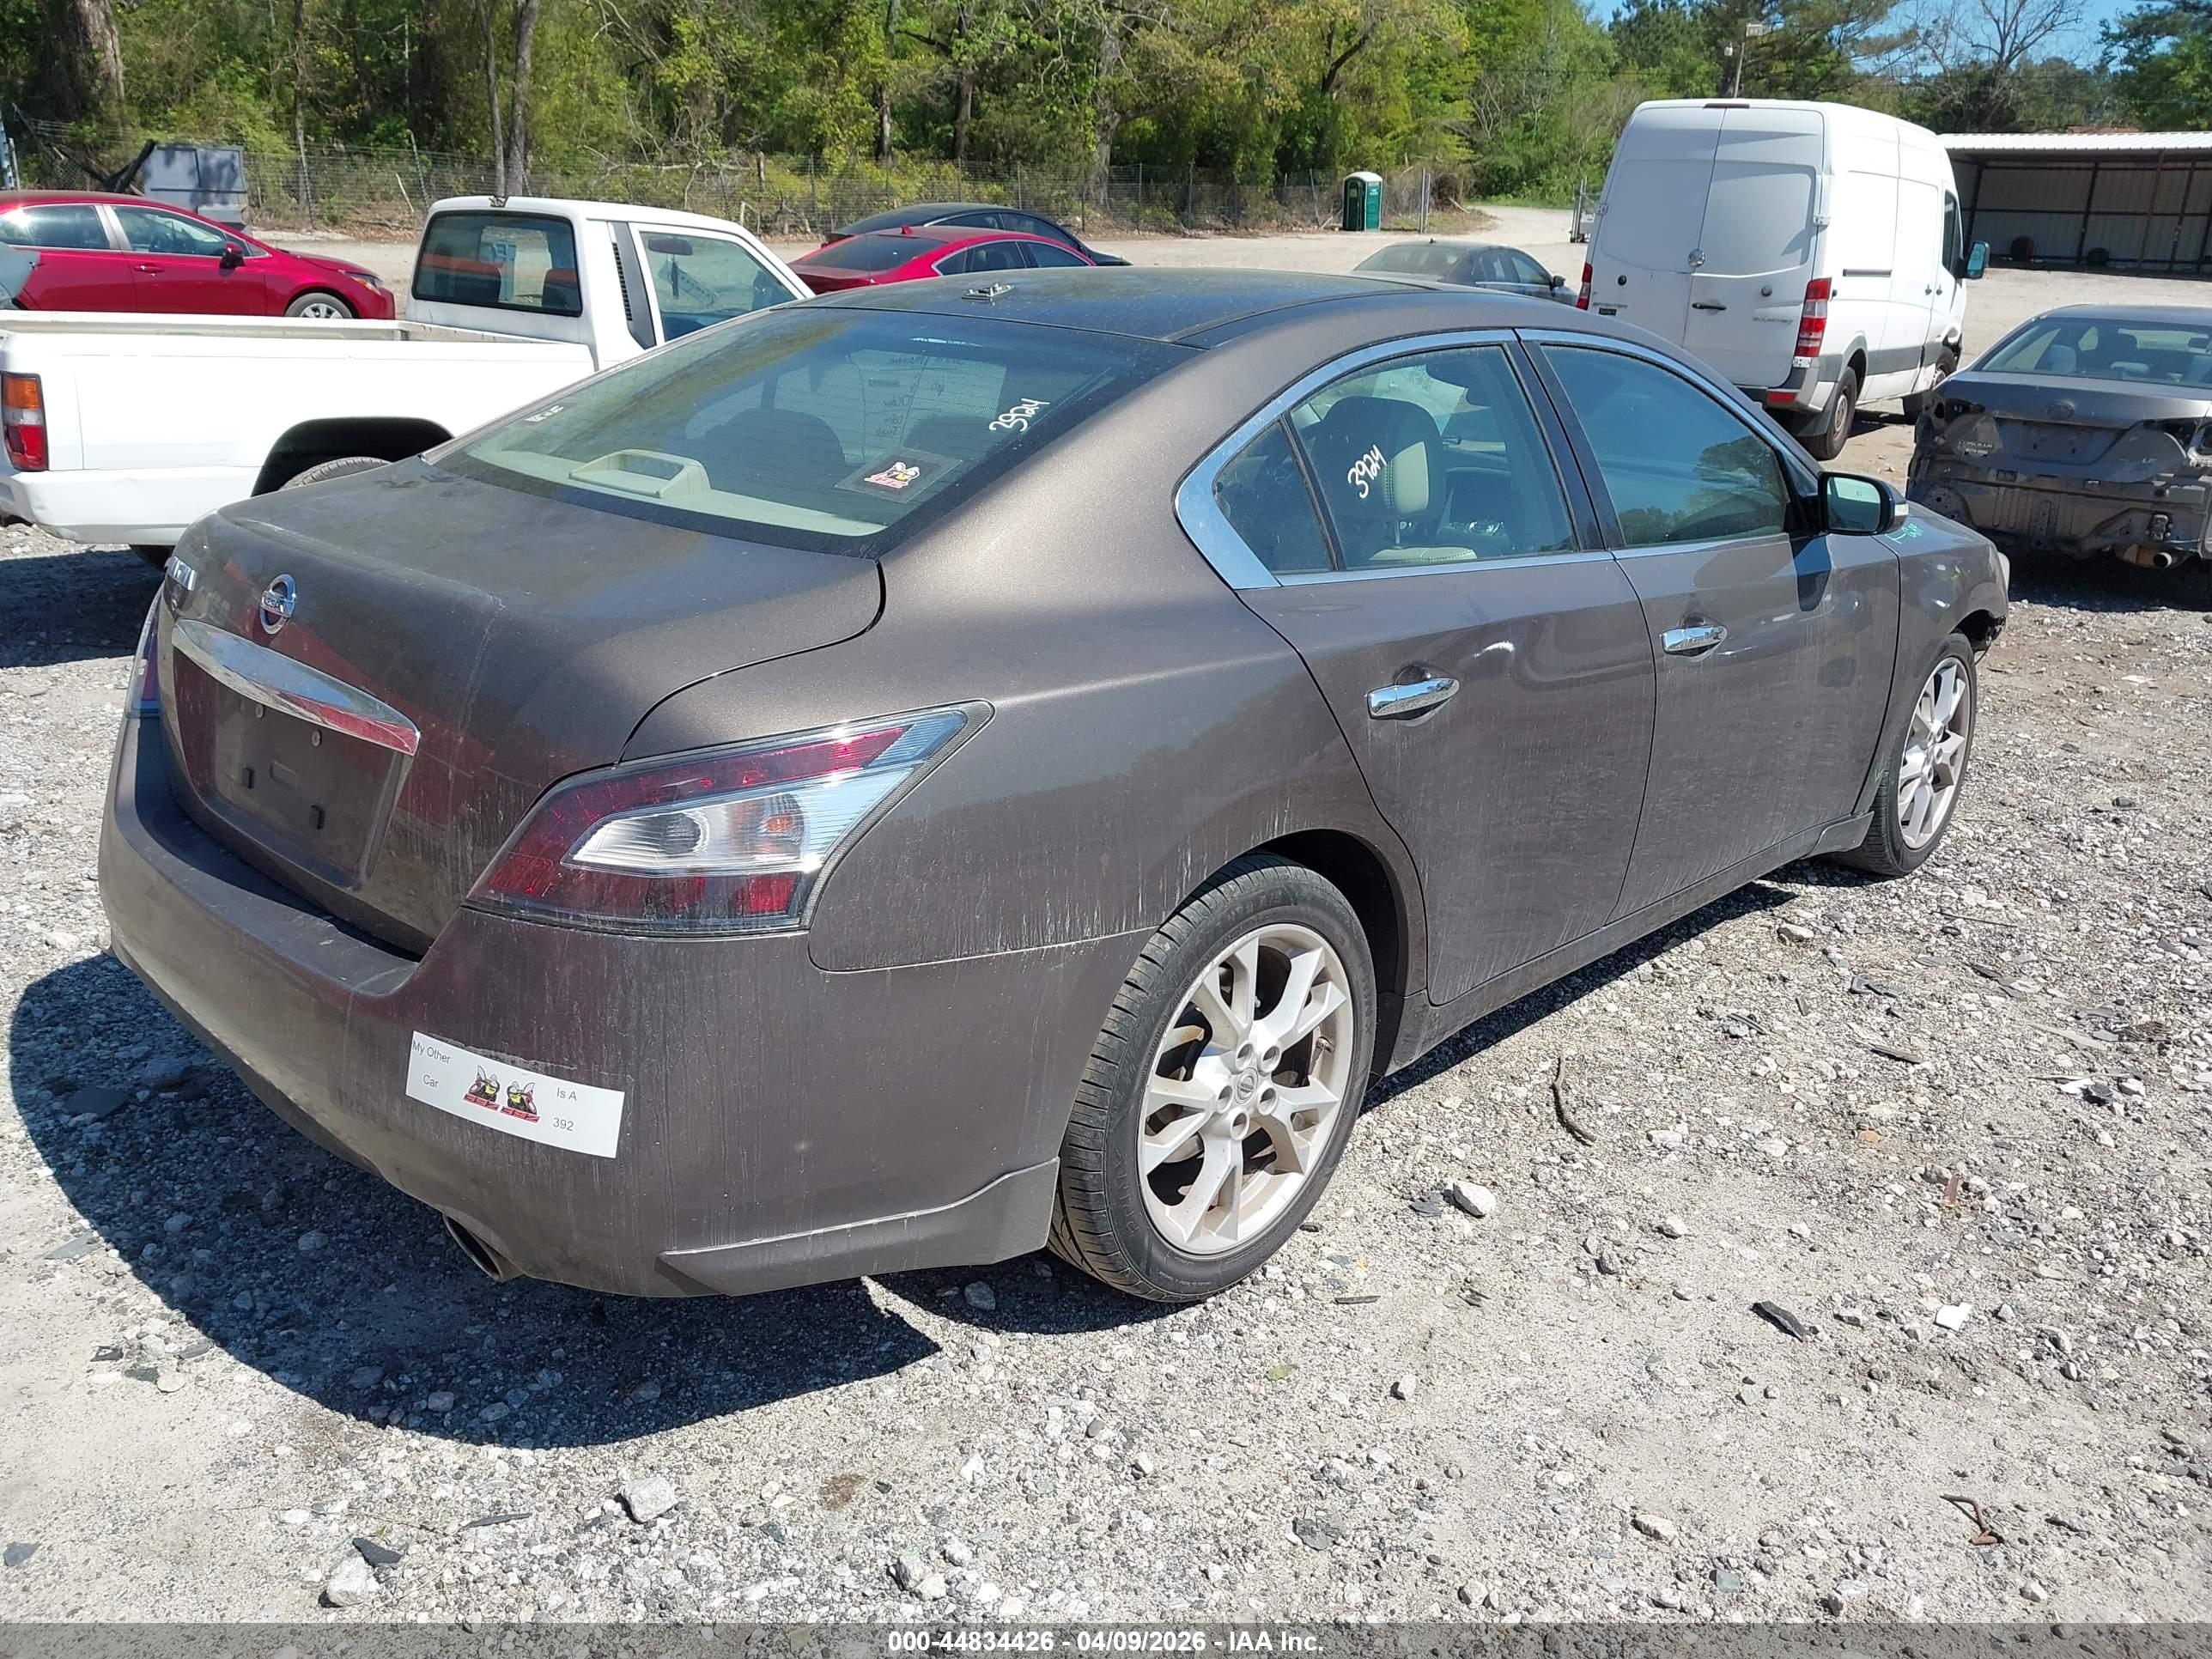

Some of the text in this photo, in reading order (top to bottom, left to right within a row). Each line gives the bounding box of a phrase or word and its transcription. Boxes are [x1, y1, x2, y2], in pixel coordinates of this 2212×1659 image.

[988, 398, 1050, 432] 3924
[1347, 444, 1388, 499] 3924
[412, 1040, 452, 1065] My Other
[422, 1073, 440, 1089] Car
[556, 1086, 577, 1102] Is A
[552, 1116, 575, 1132] 392
